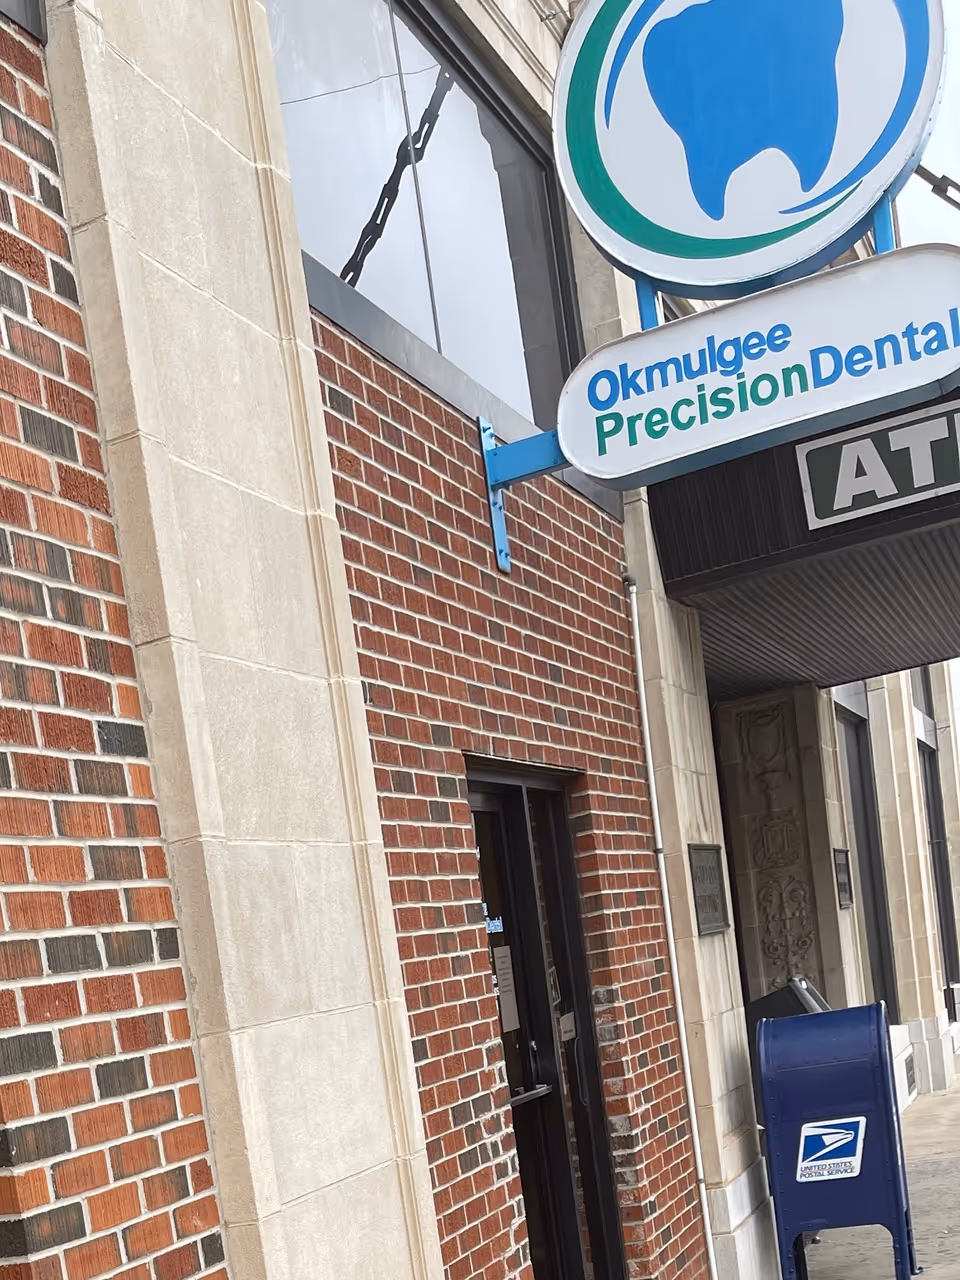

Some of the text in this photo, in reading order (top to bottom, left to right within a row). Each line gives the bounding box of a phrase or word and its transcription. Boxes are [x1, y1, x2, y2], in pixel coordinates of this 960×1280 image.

[587, 323, 792, 411] Okmulgee
[833, 414, 960, 511] AT
[800, 1161, 853, 1172] UNITED STATES
[800, 1171, 826, 1179] POSTAL
